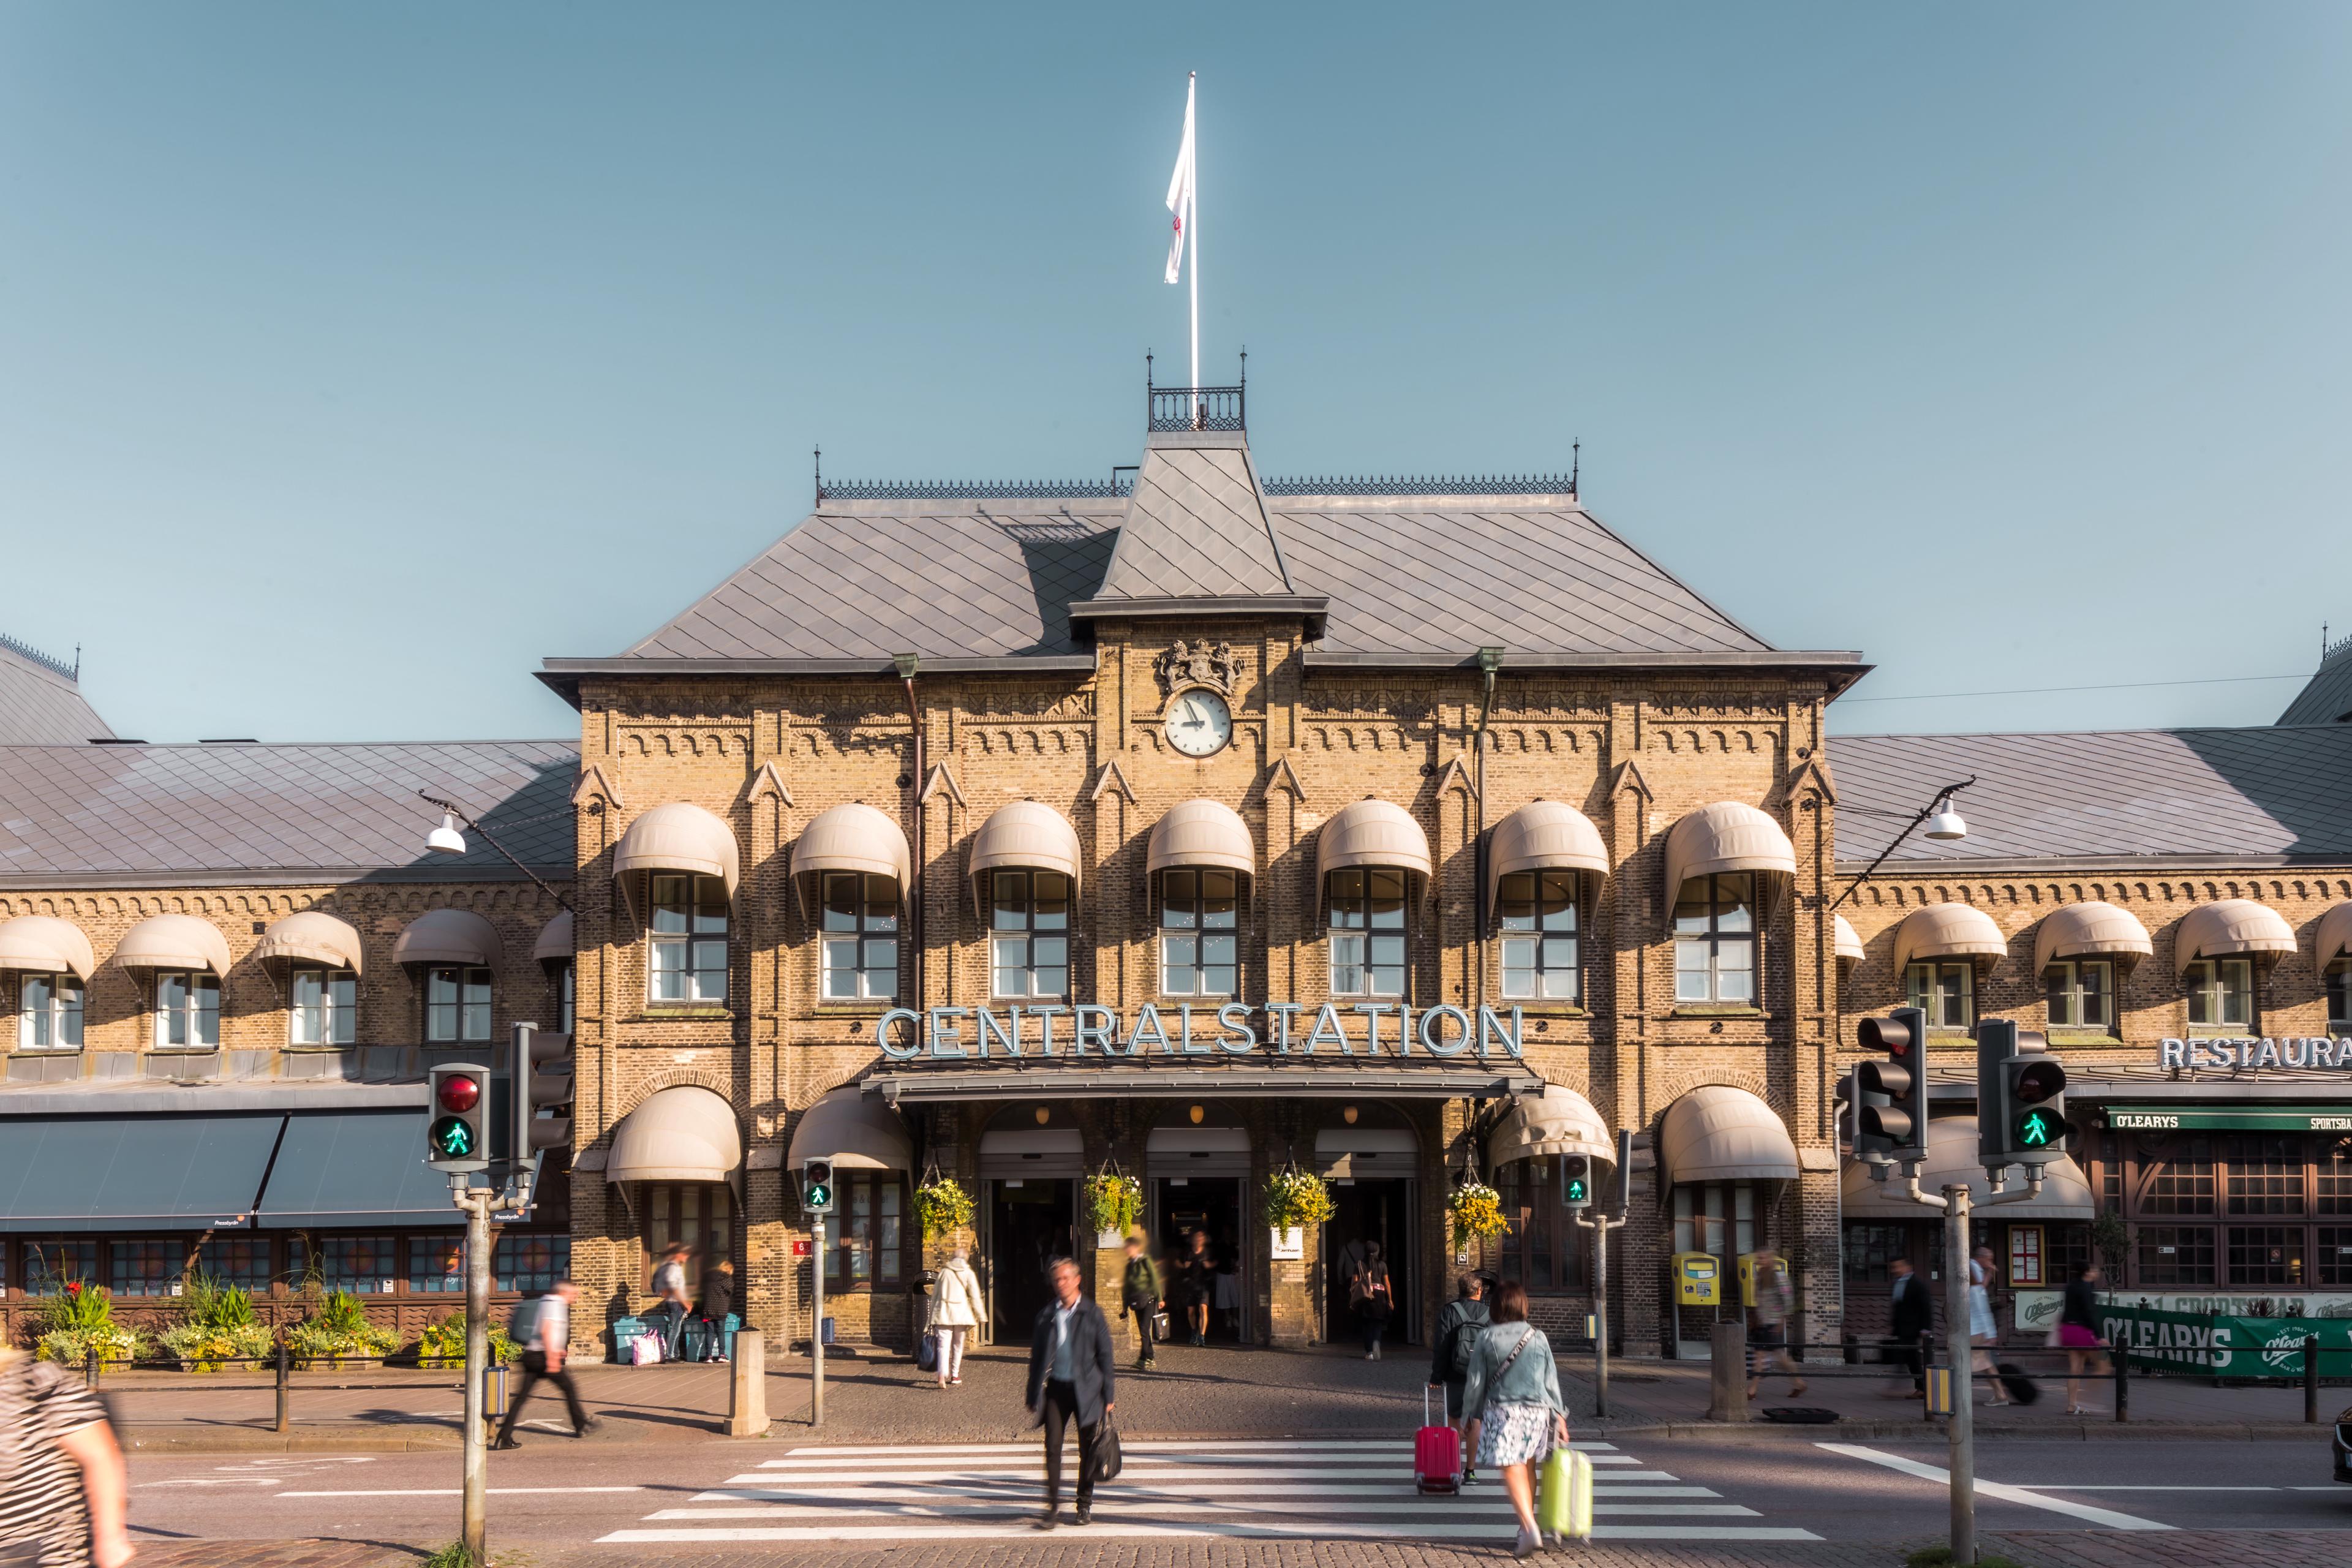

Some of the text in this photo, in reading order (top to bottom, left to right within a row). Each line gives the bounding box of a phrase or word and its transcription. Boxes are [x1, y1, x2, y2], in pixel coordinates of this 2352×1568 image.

[876, 1002, 1522, 1060] CENTRALSTATION
[2160, 1037, 2352, 1067] RESTAURA
[2117, 1115, 2179, 1128] O'LEARYS
[2103, 1317, 2233, 1367] O'LEARYS
